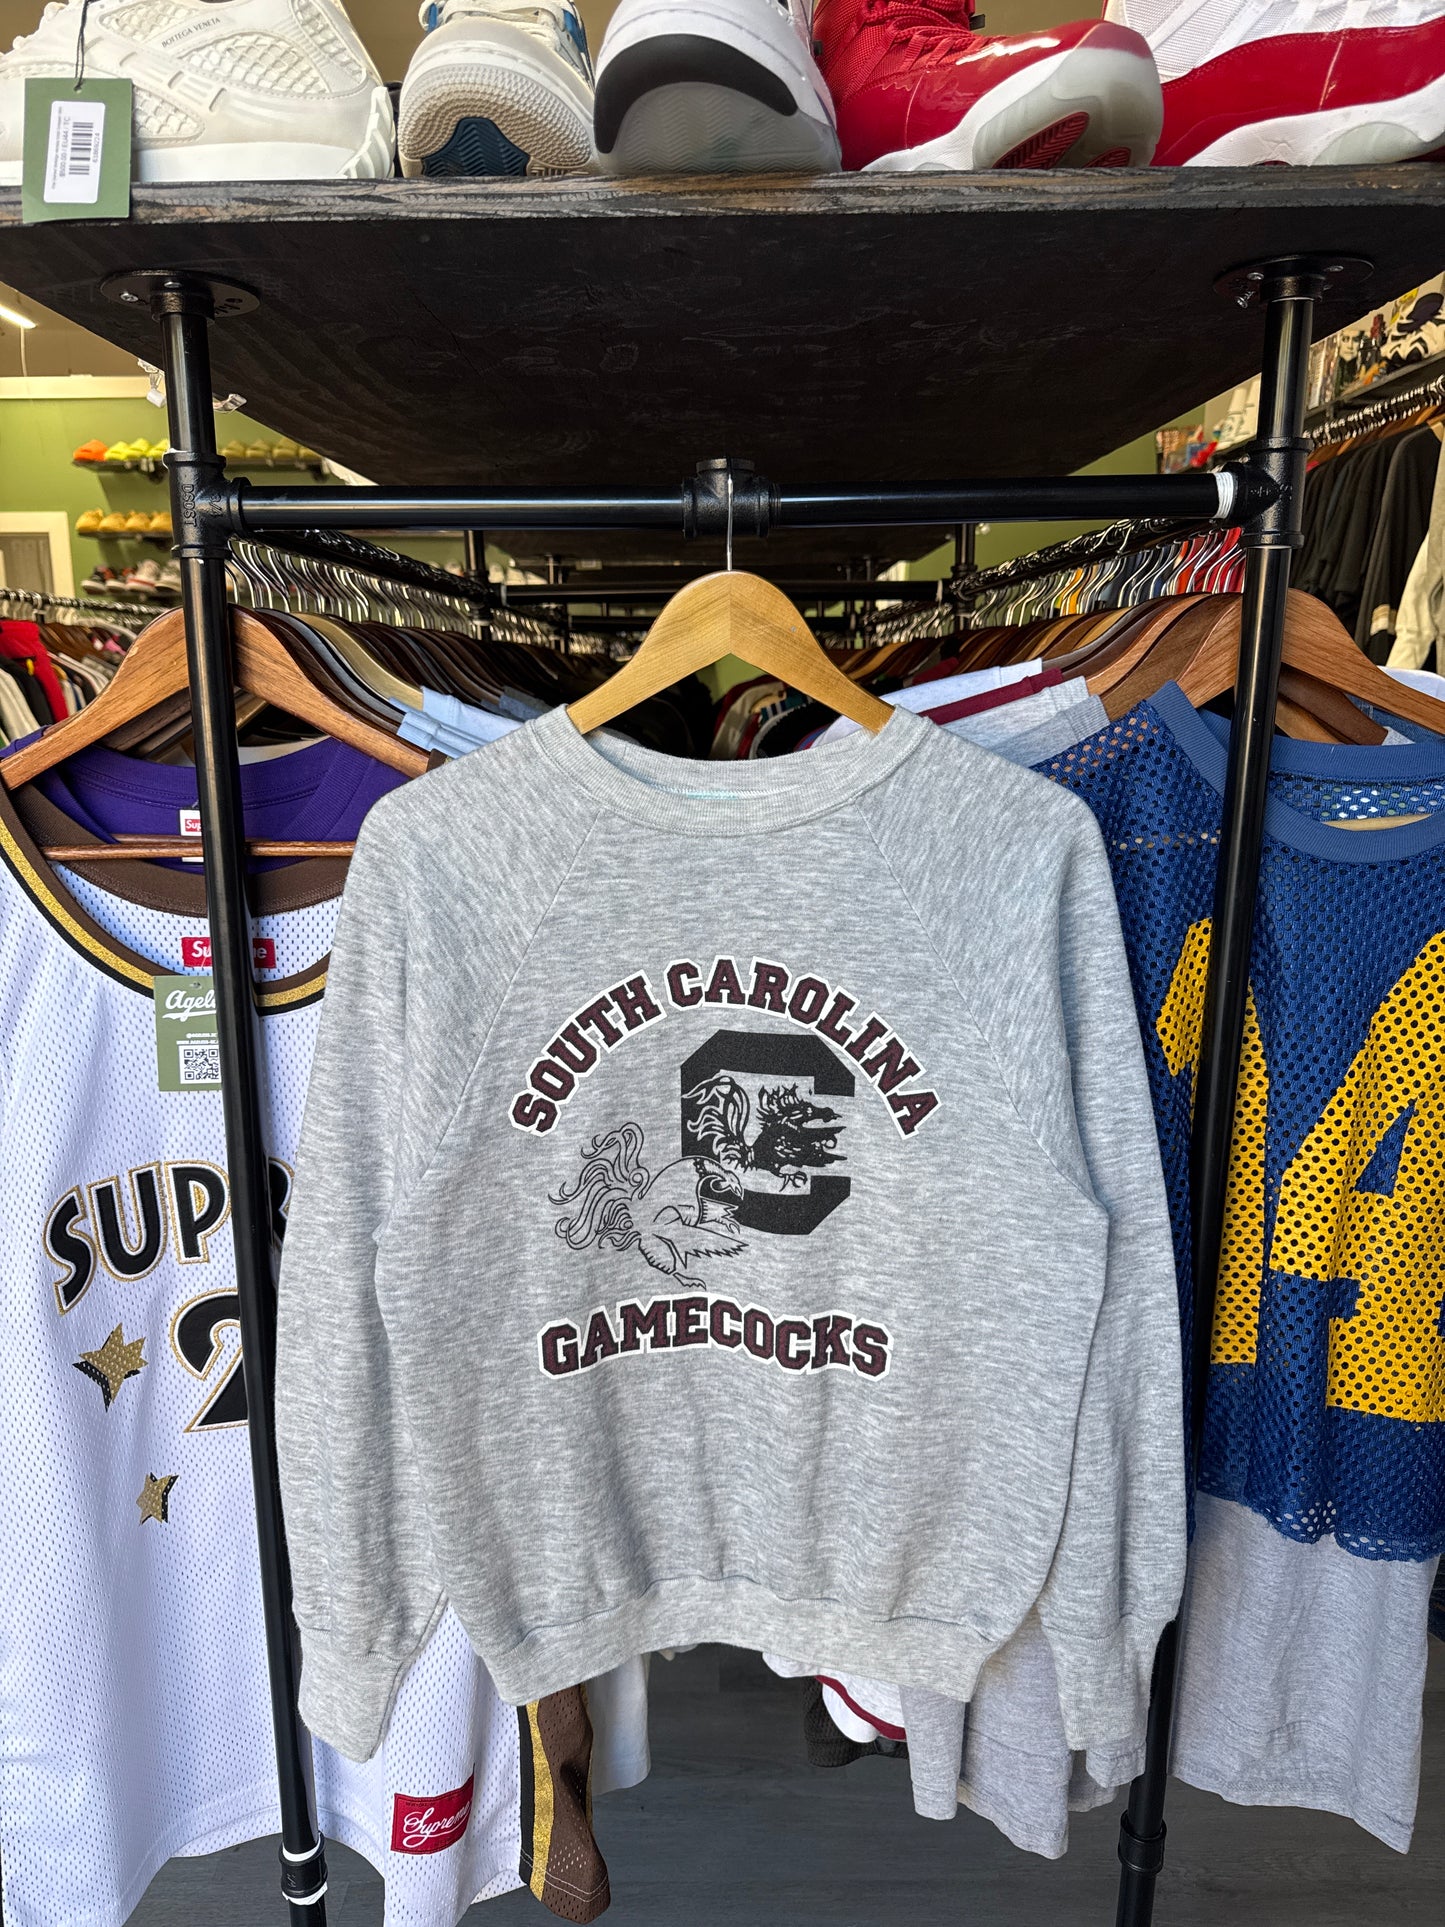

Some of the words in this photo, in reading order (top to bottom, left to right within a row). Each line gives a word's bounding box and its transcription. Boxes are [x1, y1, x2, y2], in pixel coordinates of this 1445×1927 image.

[162, 29, 193, 48] BOTTEGA
[193, 17, 221, 31] VENETA
[508, 969, 668, 1137] SOUTH
[664, 955, 942, 1140] CAROLINA
[538, 1291, 893, 1382] GAMECOCKS
